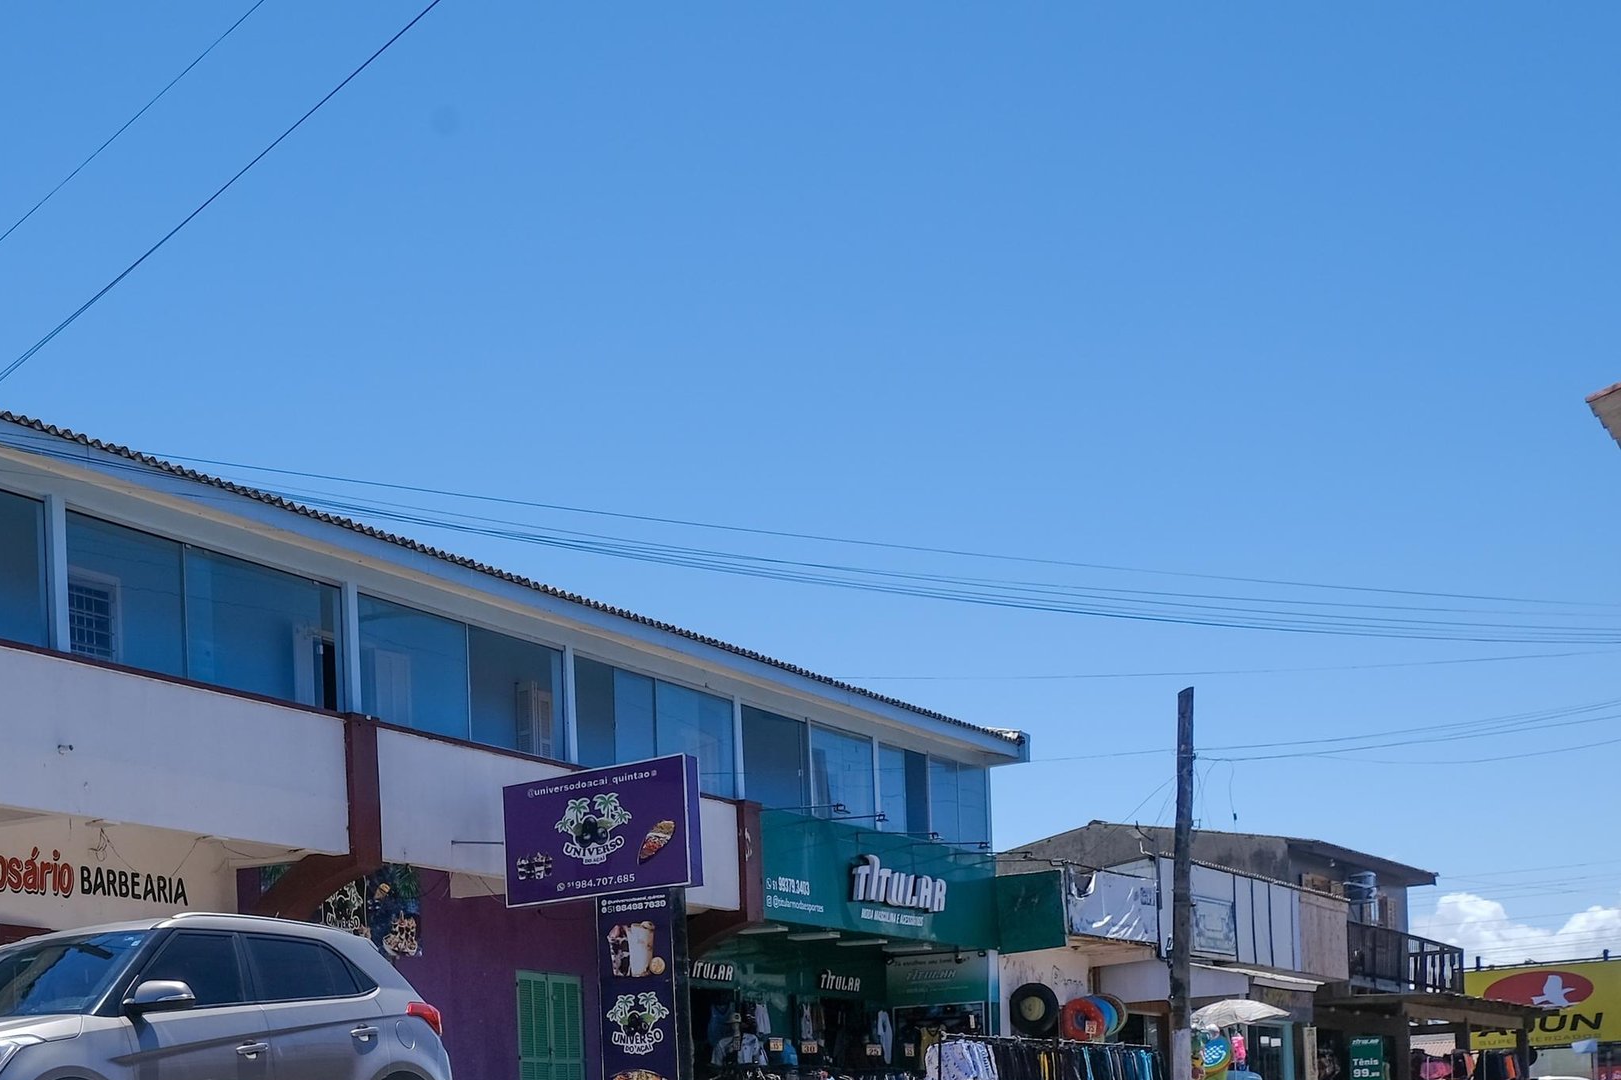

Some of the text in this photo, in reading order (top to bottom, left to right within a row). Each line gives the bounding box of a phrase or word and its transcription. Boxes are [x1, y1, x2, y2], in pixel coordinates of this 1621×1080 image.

[564, 836, 625, 858] UNIVERSO
[80, 866, 189, 906] BARBEARIA
[852, 854, 947, 913] TITULAR
[821, 969, 861, 992] TITULAR
[612, 1028, 664, 1046] UNIVERSO
[1352, 1058, 1380, 1066] Tênis
